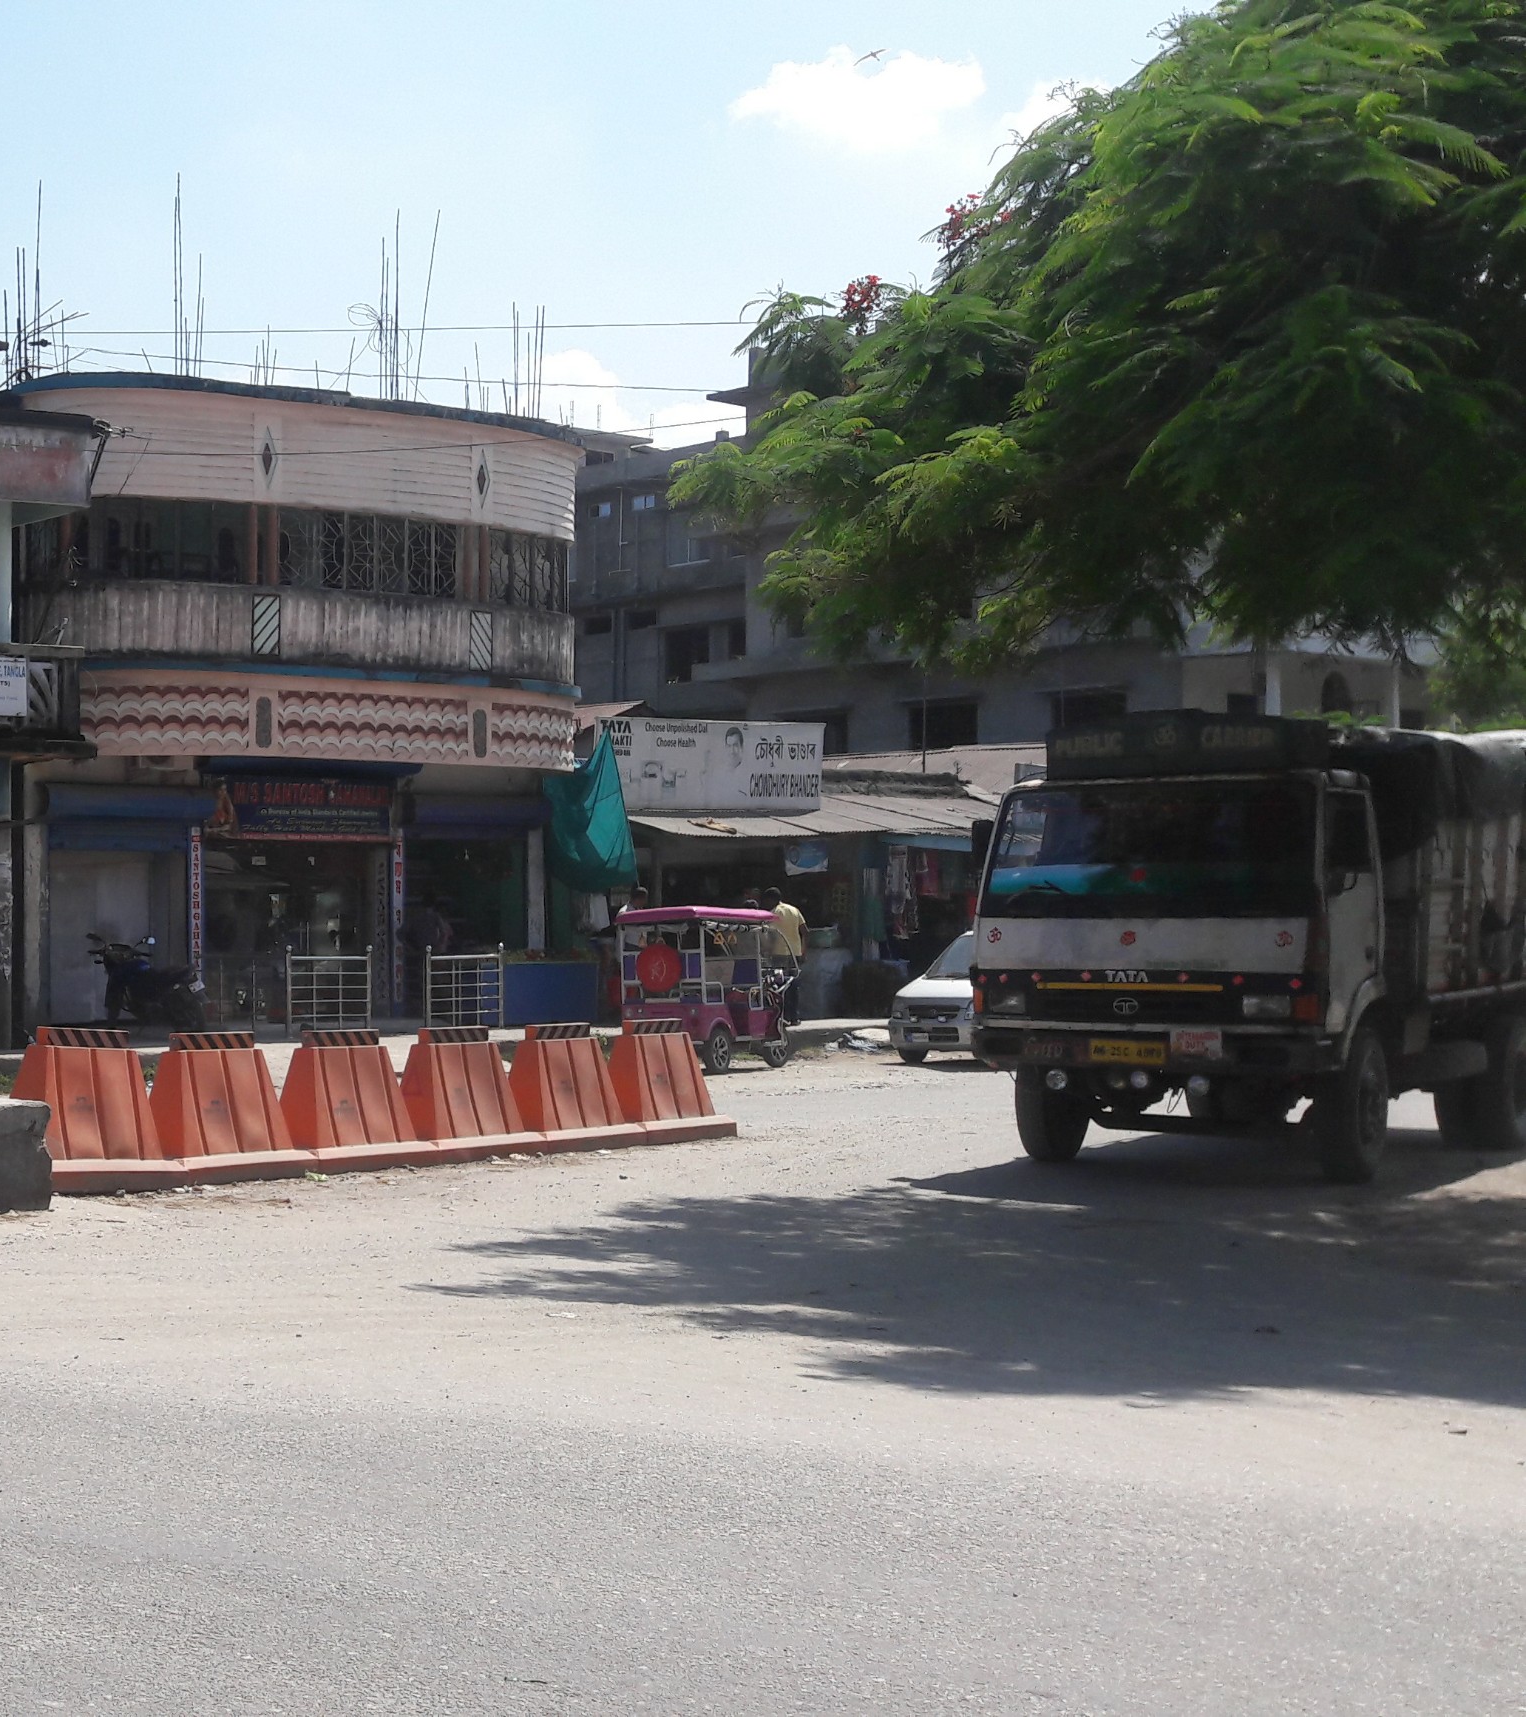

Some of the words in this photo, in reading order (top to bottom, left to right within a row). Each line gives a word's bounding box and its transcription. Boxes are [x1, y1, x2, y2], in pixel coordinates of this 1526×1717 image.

[600, 719, 632, 734] TATA
[645, 721, 665, 732] Choose
[656, 737, 677, 747] Choose
[677, 738, 697, 748] Health
[750, 773, 790, 798] CHOWDHURY
[790, 773, 819, 798] BHANDER
[263, 782, 325, 806] SANTOSH
[192, 843, 201, 909] SANTOSH
[1104, 970, 1149, 984] TATA
